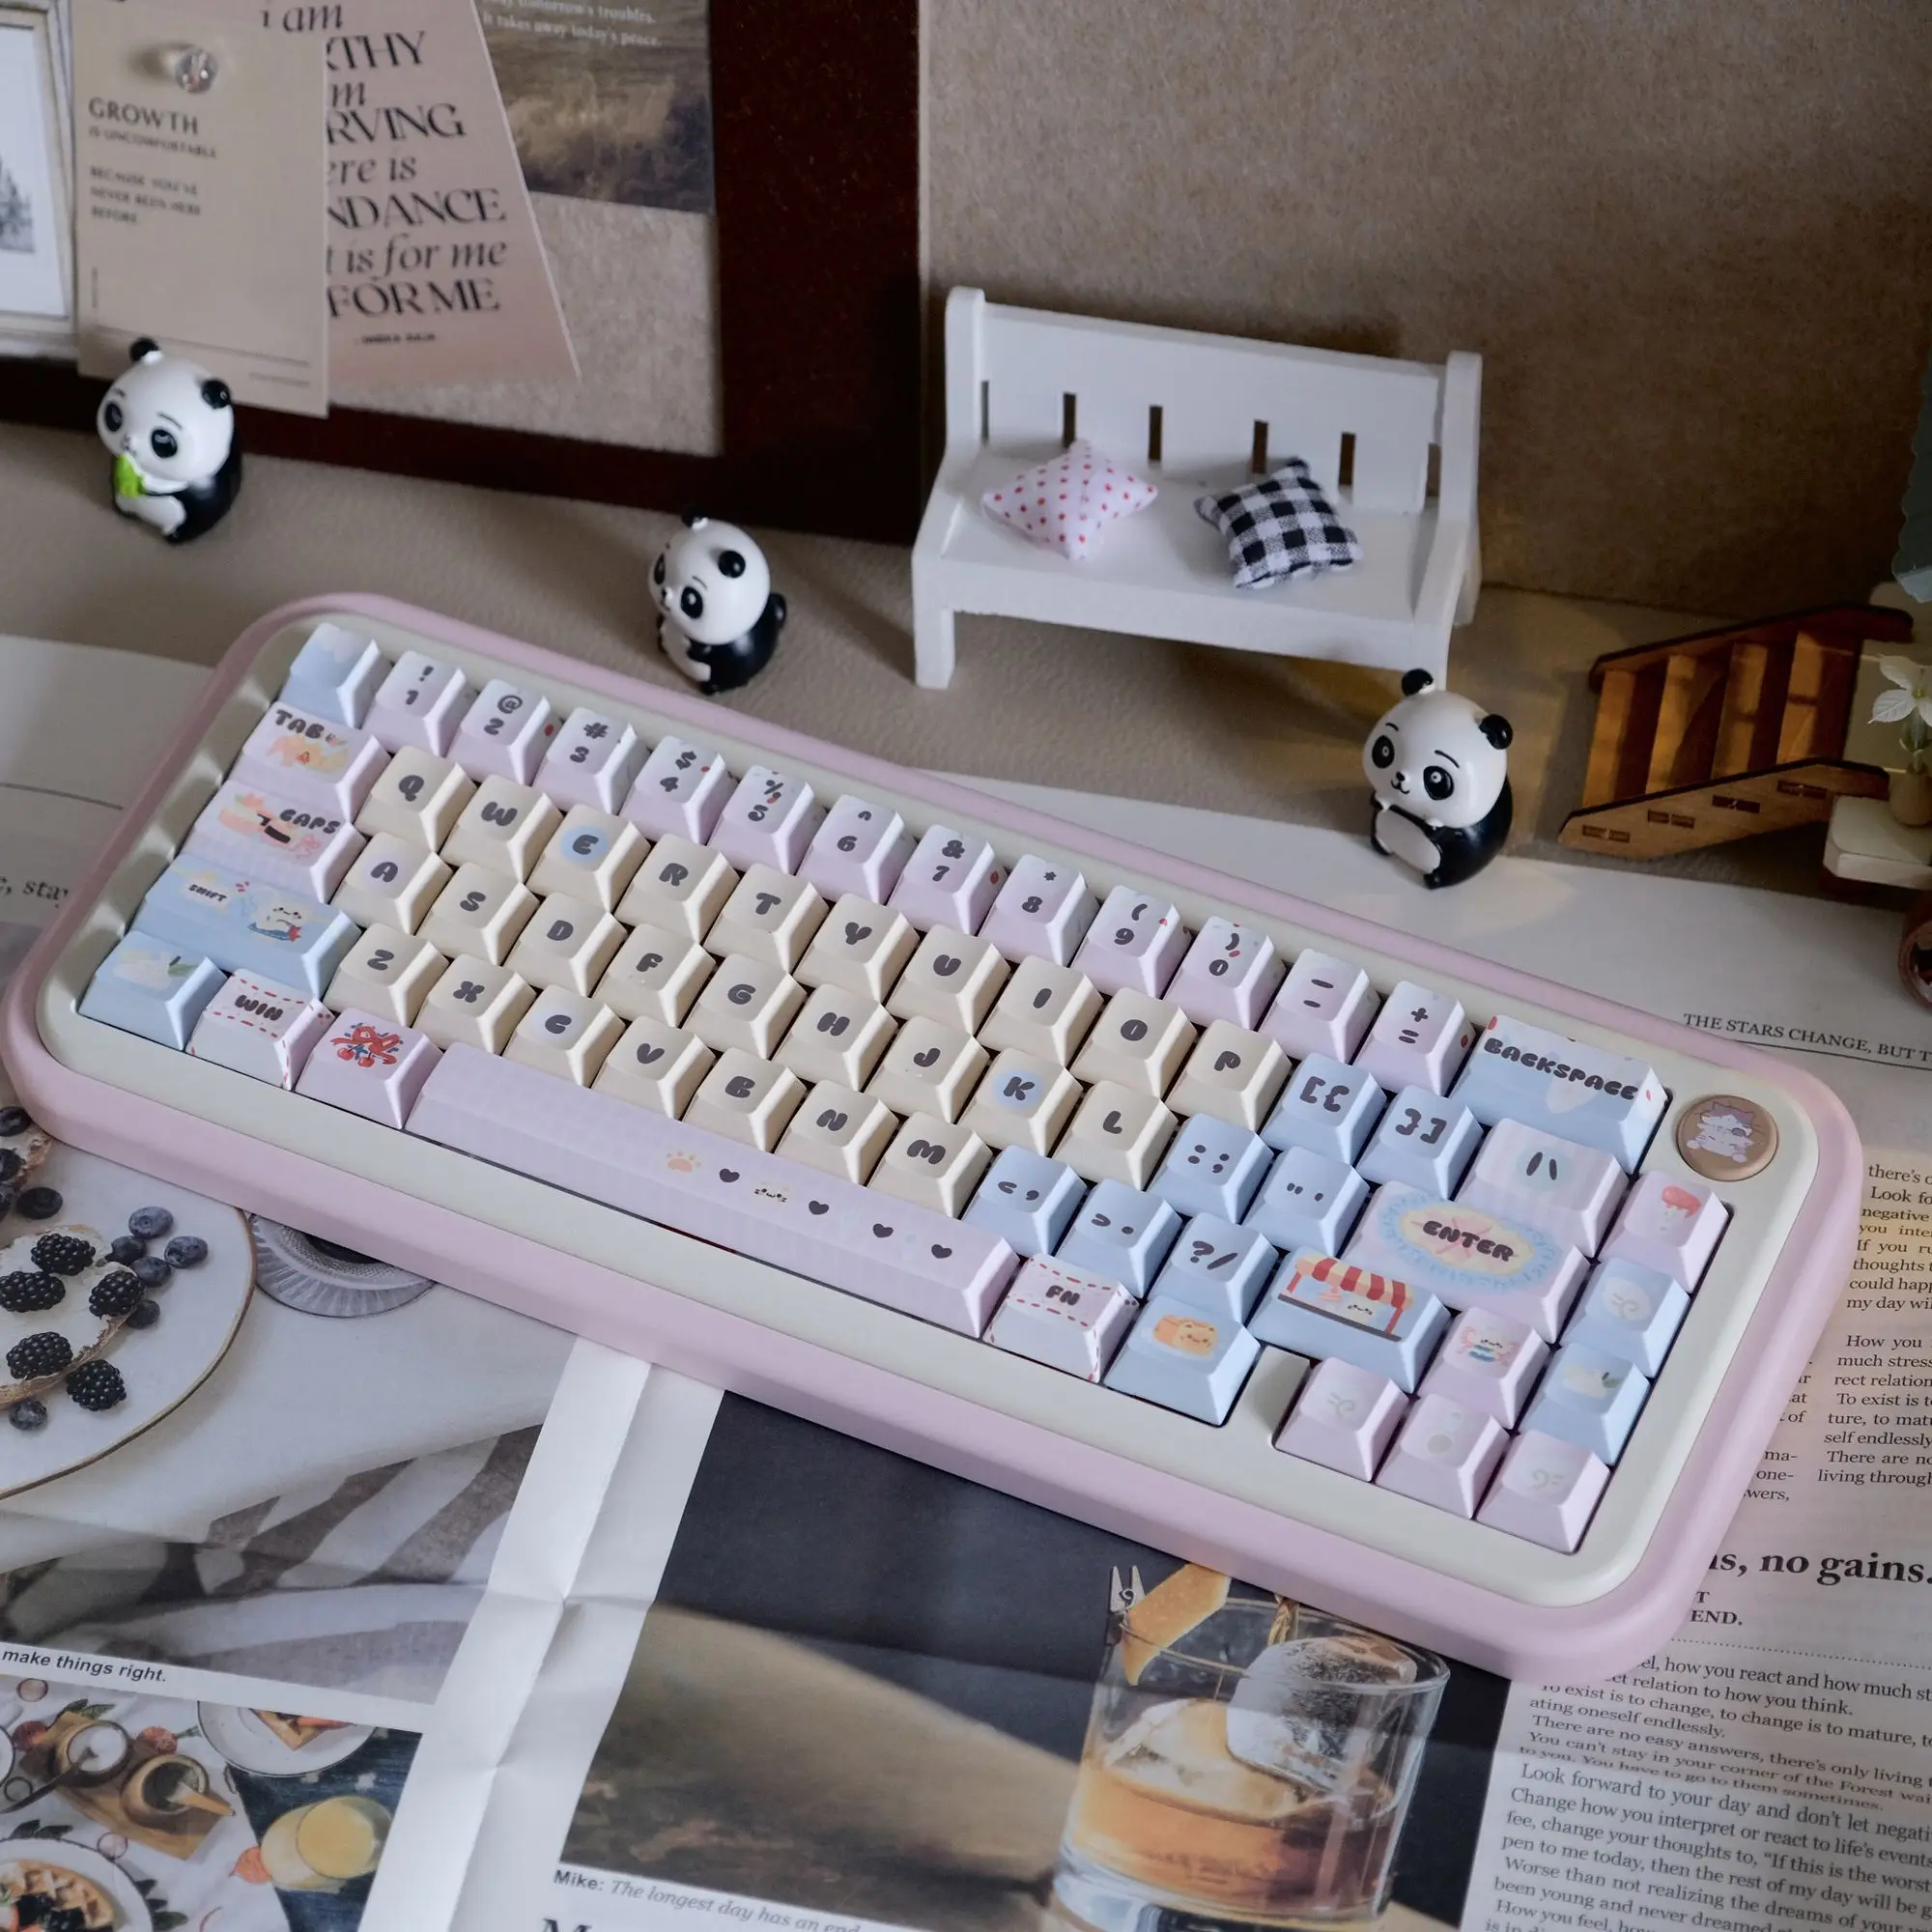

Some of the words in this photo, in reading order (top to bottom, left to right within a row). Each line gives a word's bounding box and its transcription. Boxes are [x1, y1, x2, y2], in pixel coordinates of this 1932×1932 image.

[282, 5, 343, 32] am
[89, 97, 198, 135] GROWTH
[389, 150, 417, 183] is
[346, 239, 374, 274] is
[381, 233, 440, 279] for
[451, 241, 507, 270] me
[427, 278, 500, 314] ME
[405, 690, 419, 705] 1
[275, 710, 325, 739] TAB
[484, 718, 504, 735] 2
[570, 746, 589, 763] 3
[399, 775, 424, 802] Q
[660, 777, 679, 792] 4
[279, 810, 340, 835] CAPS
[481, 802, 518, 826] W
[748, 804, 769, 821] 5
[572, 834, 599, 855] E
[837, 836, 858, 852] 6
[371, 862, 398, 883] A
[659, 863, 689, 887] R
[931, 865, 951, 882] 7
[188, 884, 228, 902] SHIFT
[460, 891, 486, 912] S
[755, 892, 781, 915] T
[1021, 895, 1043, 913] 8
[547, 920, 574, 941] D
[845, 922, 872, 946] Y
[1114, 927, 1135, 946] 9
[636, 952, 664, 973] F
[933, 953, 961, 977] U
[453, 980, 485, 1004] X
[727, 983, 756, 1006] G
[235, 994, 283, 1021] WIN
[545, 1014, 572, 1034] C
[816, 1011, 850, 1037] H
[1684, 1013, 1722, 1030] THE
[1725, 1019, 1784, 1038] STARS
[1788, 1028, 1872, 1054] CHANGE,
[1877, 1043, 1916, 1060] BUT
[636, 1043, 665, 1065] V
[913, 1047, 941, 1067] J
[1213, 1050, 1241, 1071] P
[1484, 1037, 1639, 1101] BACKSPACE
[724, 1075, 755, 1098] B
[1003, 1076, 1035, 1101] K
[816, 1109, 848, 1132] N
[1102, 1111, 1122, 1135] L
[906, 1139, 947, 1165] M
[1868, 1163, 1921, 1183] there's
[1870, 1185, 1913, 1203] Look
[1861, 1208, 1930, 1222] negative
[1859, 1224, 1888, 1235] you
[1422, 1220, 1515, 1263] ENTER
[1857, 1238, 1871, 1252] If
[1877, 1242, 1908, 1255] you
[1853, 1258, 1925, 1274] thoughts
[1849, 1277, 1894, 1291] could
[1045, 1285, 1080, 1306] FN
[1846, 1297, 1873, 1312] my
[1876, 1295, 1906, 1312] day
[1846, 1334, 1885, 1349] How
[1890, 1337, 1922, 1351] you
[1836, 1353, 1883, 1368] much
[1834, 1374, 1867, 1386] rect
[1836, 1392, 1857, 1406] To
[1861, 1392, 1900, 1406] exist
[1905, 1393, 1918, 1407] is
[1788, 1410, 1807, 1423] of
[1828, 1412, 1866, 1427] ture,
[1873, 1413, 1889, 1426] to
[1824, 1432, 1856, 1444] self
[1827, 1450, 1875, 1464] There
[1881, 1454, 1909, 1465] are
[1818, 1469, 1865, 1486] living
[1759, 1553, 1809, 1574] no
[1816, 1551, 1932, 1586] gains.
[1690, 1609, 1743, 1626] END.
[2, 1650, 51, 1666] make
[56, 1656, 114, 1677] things
[118, 1664, 166, 1683] right.
[1664, 1657, 1701, 1673] how
[1702, 1664, 1735, 1679] you
[1740, 1667, 1782, 1685] react
[1786, 1672, 1820, 1689] and
[1824, 1674, 1860, 1692] how
[1863, 1682, 1912, 1700] much
[1633, 1676, 1698, 1695] relation
[1703, 1685, 1720, 1698] to
[1724, 1687, 1762, 1703] how
[1764, 1692, 1796, 1709] you
[1802, 1696, 1854, 1716] think.
[1529, 1698, 1573, 1717] ating
[1577, 1704, 1642, 1724] oneself
[1643, 1712, 1725, 1739] endlessly.
[1565, 1685, 1605, 1700] exist
[1610, 1689, 1624, 1703] is
[1629, 1692, 1645, 1706] to
[1649, 1694, 1715, 1719] change,
[1720, 1707, 1737, 1720] to
[1741, 1711, 1804, 1732] change
[1807, 1719, 1822, 1733] is
[1827, 1722, 1843, 1736] to
[1848, 1728, 1917, 1747] mature,
[1532, 1715, 1582, 1733] There
[1586, 1725, 1614, 1738] are
[1619, 1730, 1641, 1743] no
[1645, 1733, 1684, 1750] easy
[1688, 1741, 1764, 1764] answers,
[1770, 1752, 1827, 1773] there's
[1832, 1765, 1870, 1780] only
[1874, 1767, 1923, 1789] living
[1520, 1762, 1565, 1785] Look
[1571, 1769, 1642, 1797] forward
[1647, 1784, 1666, 1801] to
[1669, 1789, 1714, 1808] your
[1719, 1794, 1751, 1812] day
[1756, 1804, 1791, 1821] and
[1796, 1806, 1841, 1829] don't
[1848, 1812, 1870, 1833] let
[1510, 1787, 1577, 1813] Change
[1579, 1797, 1619, 1818] how
[1620, 1806, 1654, 1825] you
[1657, 1810, 1736, 1837] interpret
[1740, 1827, 1761, 1840] or
[1763, 1830, 1809, 1849] react
[1812, 1836, 1831, 1852] to
[1834, 1837, 1874, 1860] life's
[553, 1869, 605, 1891] Mike:
[611, 1879, 642, 1899] The
[647, 1885, 714, 1913] longest
[717, 1901, 753, 1921] day
[758, 1907, 791, 1927] has
